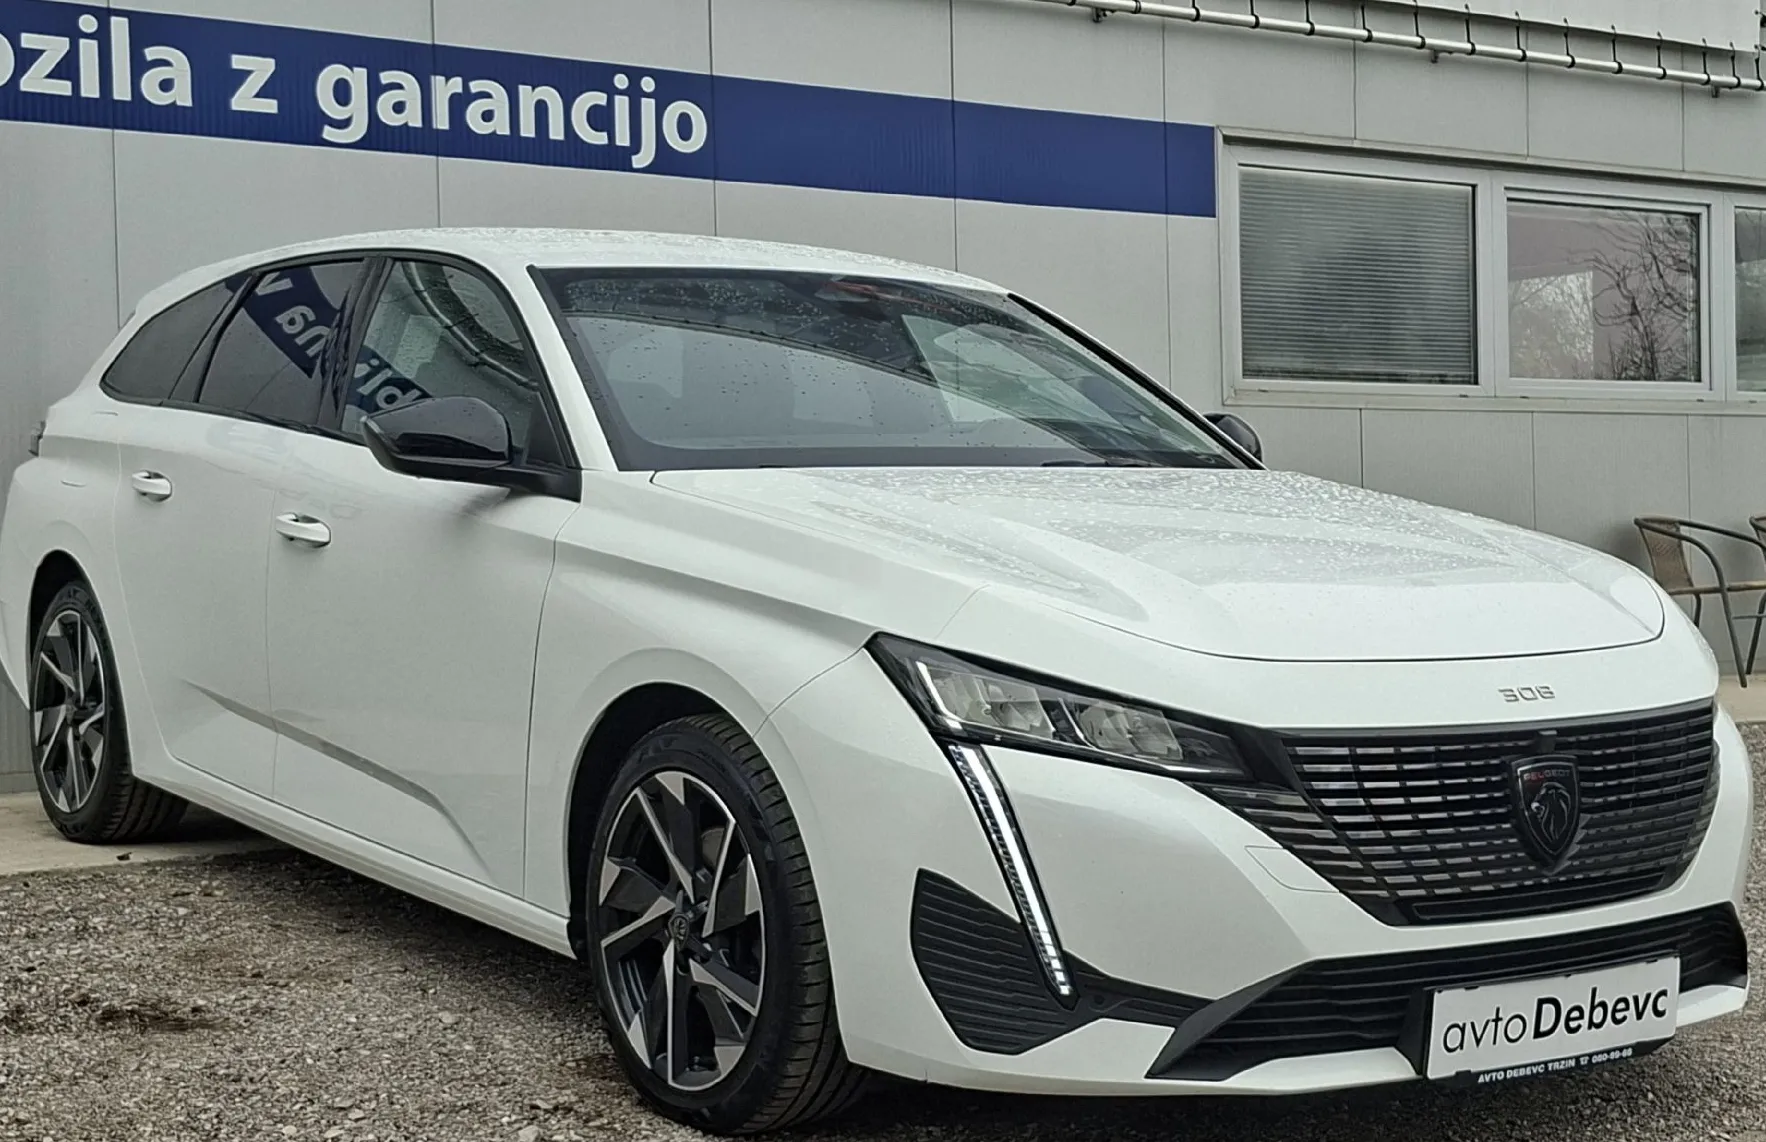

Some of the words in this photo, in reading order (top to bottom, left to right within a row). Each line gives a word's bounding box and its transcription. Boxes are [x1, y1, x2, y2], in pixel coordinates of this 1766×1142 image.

[0, 15, 193, 107] zila
[230, 54, 278, 114] z
[316, 61, 708, 168] garancijo
[1498, 685, 1556, 702] 308
[1523, 769, 1571, 781] PEUGEOT
[1478, 1071, 1505, 1084] AVTO
[1506, 1065, 1545, 1080] DEBEVC
[1547, 1058, 1576, 1072] TRZIN
